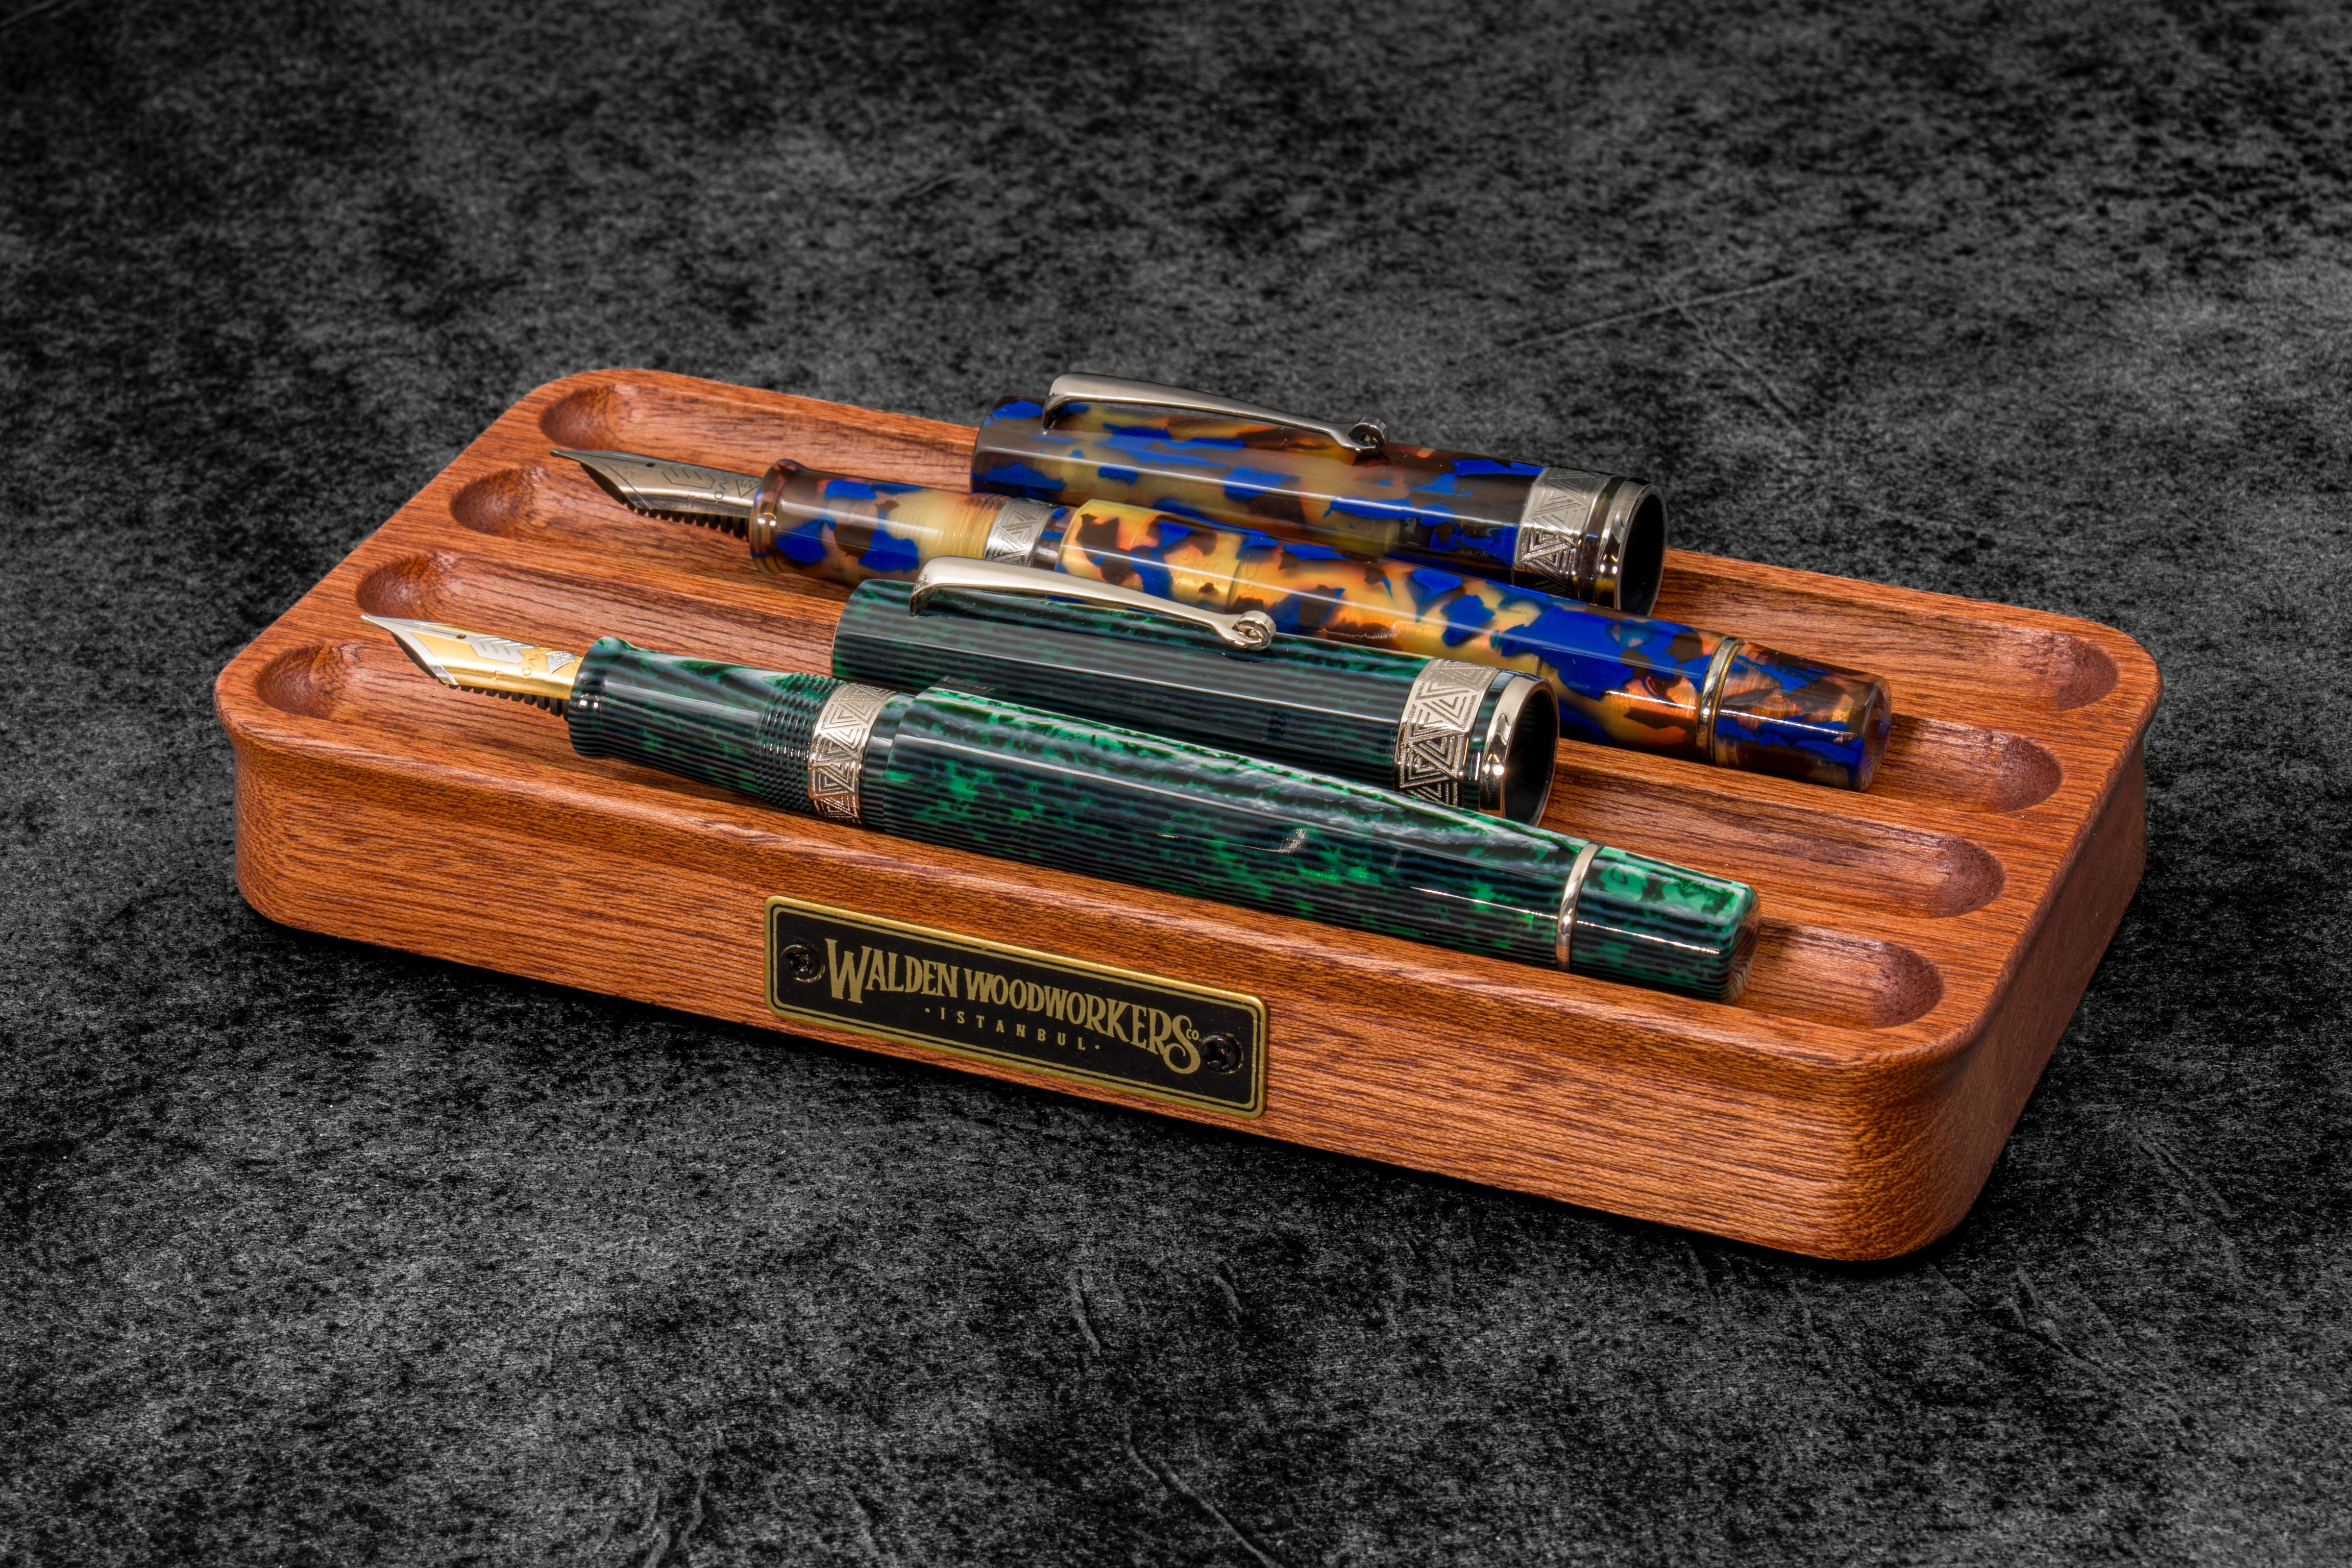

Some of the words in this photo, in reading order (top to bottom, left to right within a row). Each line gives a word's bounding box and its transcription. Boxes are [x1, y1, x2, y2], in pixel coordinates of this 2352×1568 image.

[824, 938, 959, 1004] WALDEN
[963, 968, 1201, 1075] WOODWORKERS
[940, 1007, 1085, 1051] ISTANBUL
